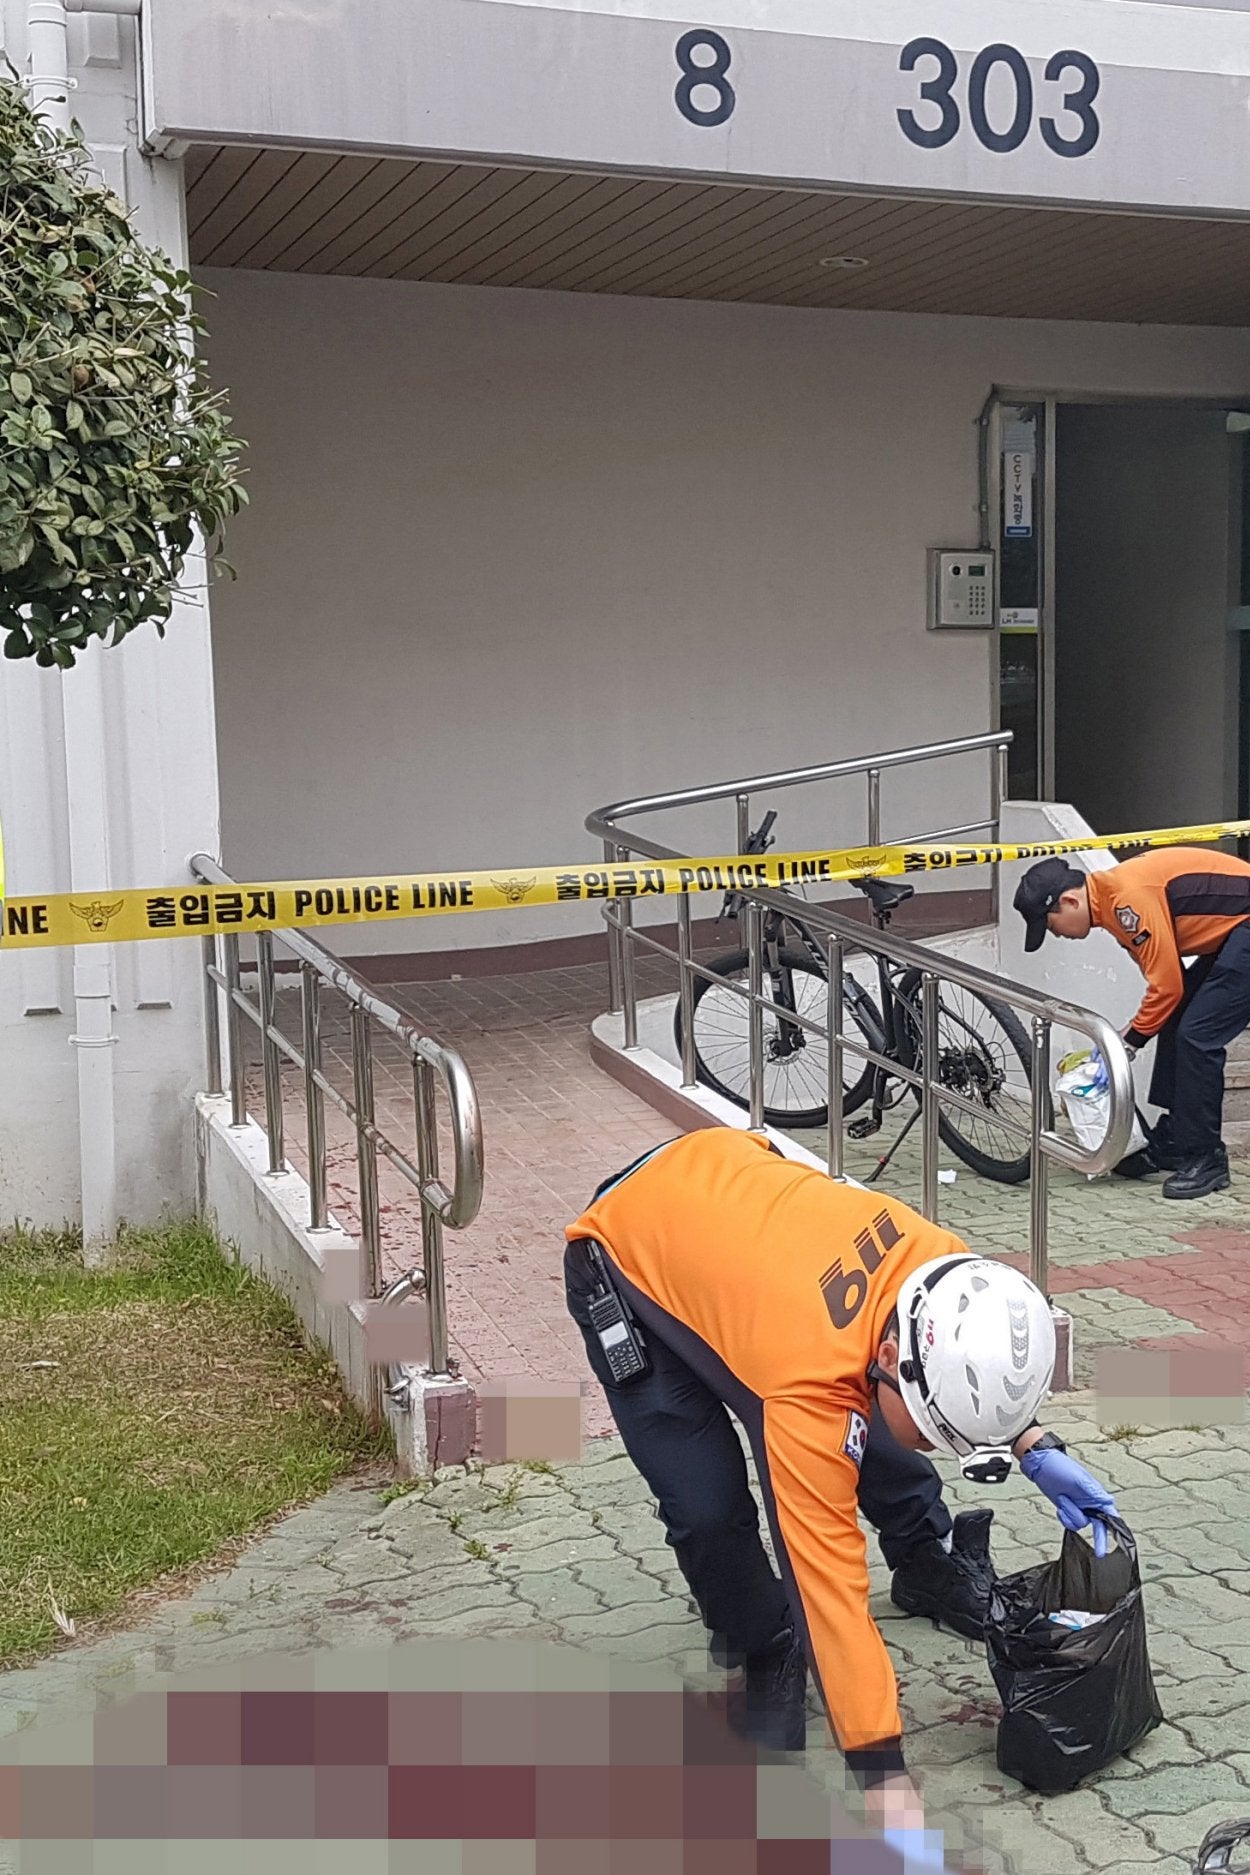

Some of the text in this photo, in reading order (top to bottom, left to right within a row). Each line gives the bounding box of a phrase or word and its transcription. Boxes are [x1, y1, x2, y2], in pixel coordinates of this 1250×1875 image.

[674, 28, 736, 127] 8
[896, 37, 1100, 158] 303
[555, 858, 832, 901] 출입금지 POLICE LINE
[145, 880, 474, 928] 출입금지 POLICE LINE
